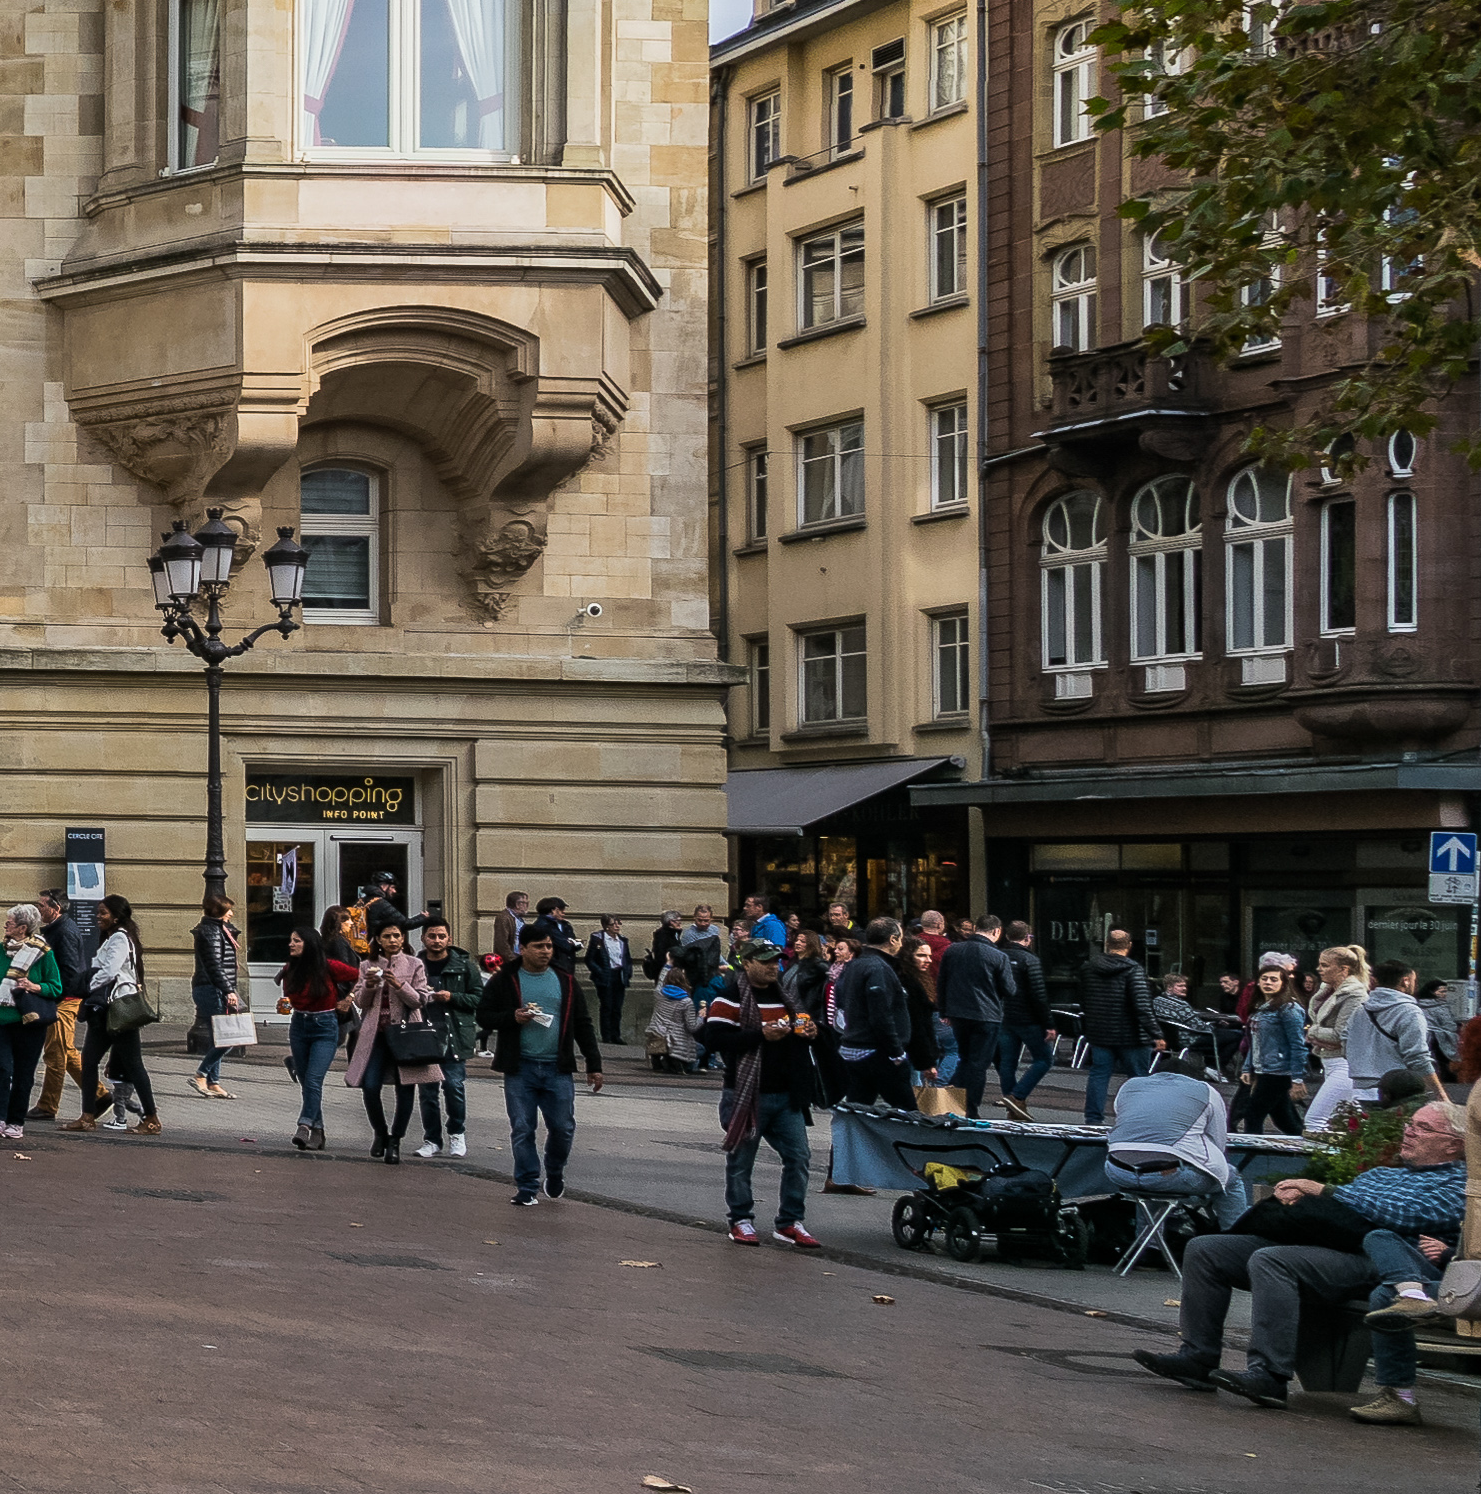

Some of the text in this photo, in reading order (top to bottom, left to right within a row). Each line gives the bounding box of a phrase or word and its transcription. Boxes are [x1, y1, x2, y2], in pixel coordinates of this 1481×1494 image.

[245, 777, 403, 812] cityshopping
[323, 810, 385, 819] INFO POINT
[1368, 919, 1399, 930] dernier
[1400, 920, 1418, 931] jour
